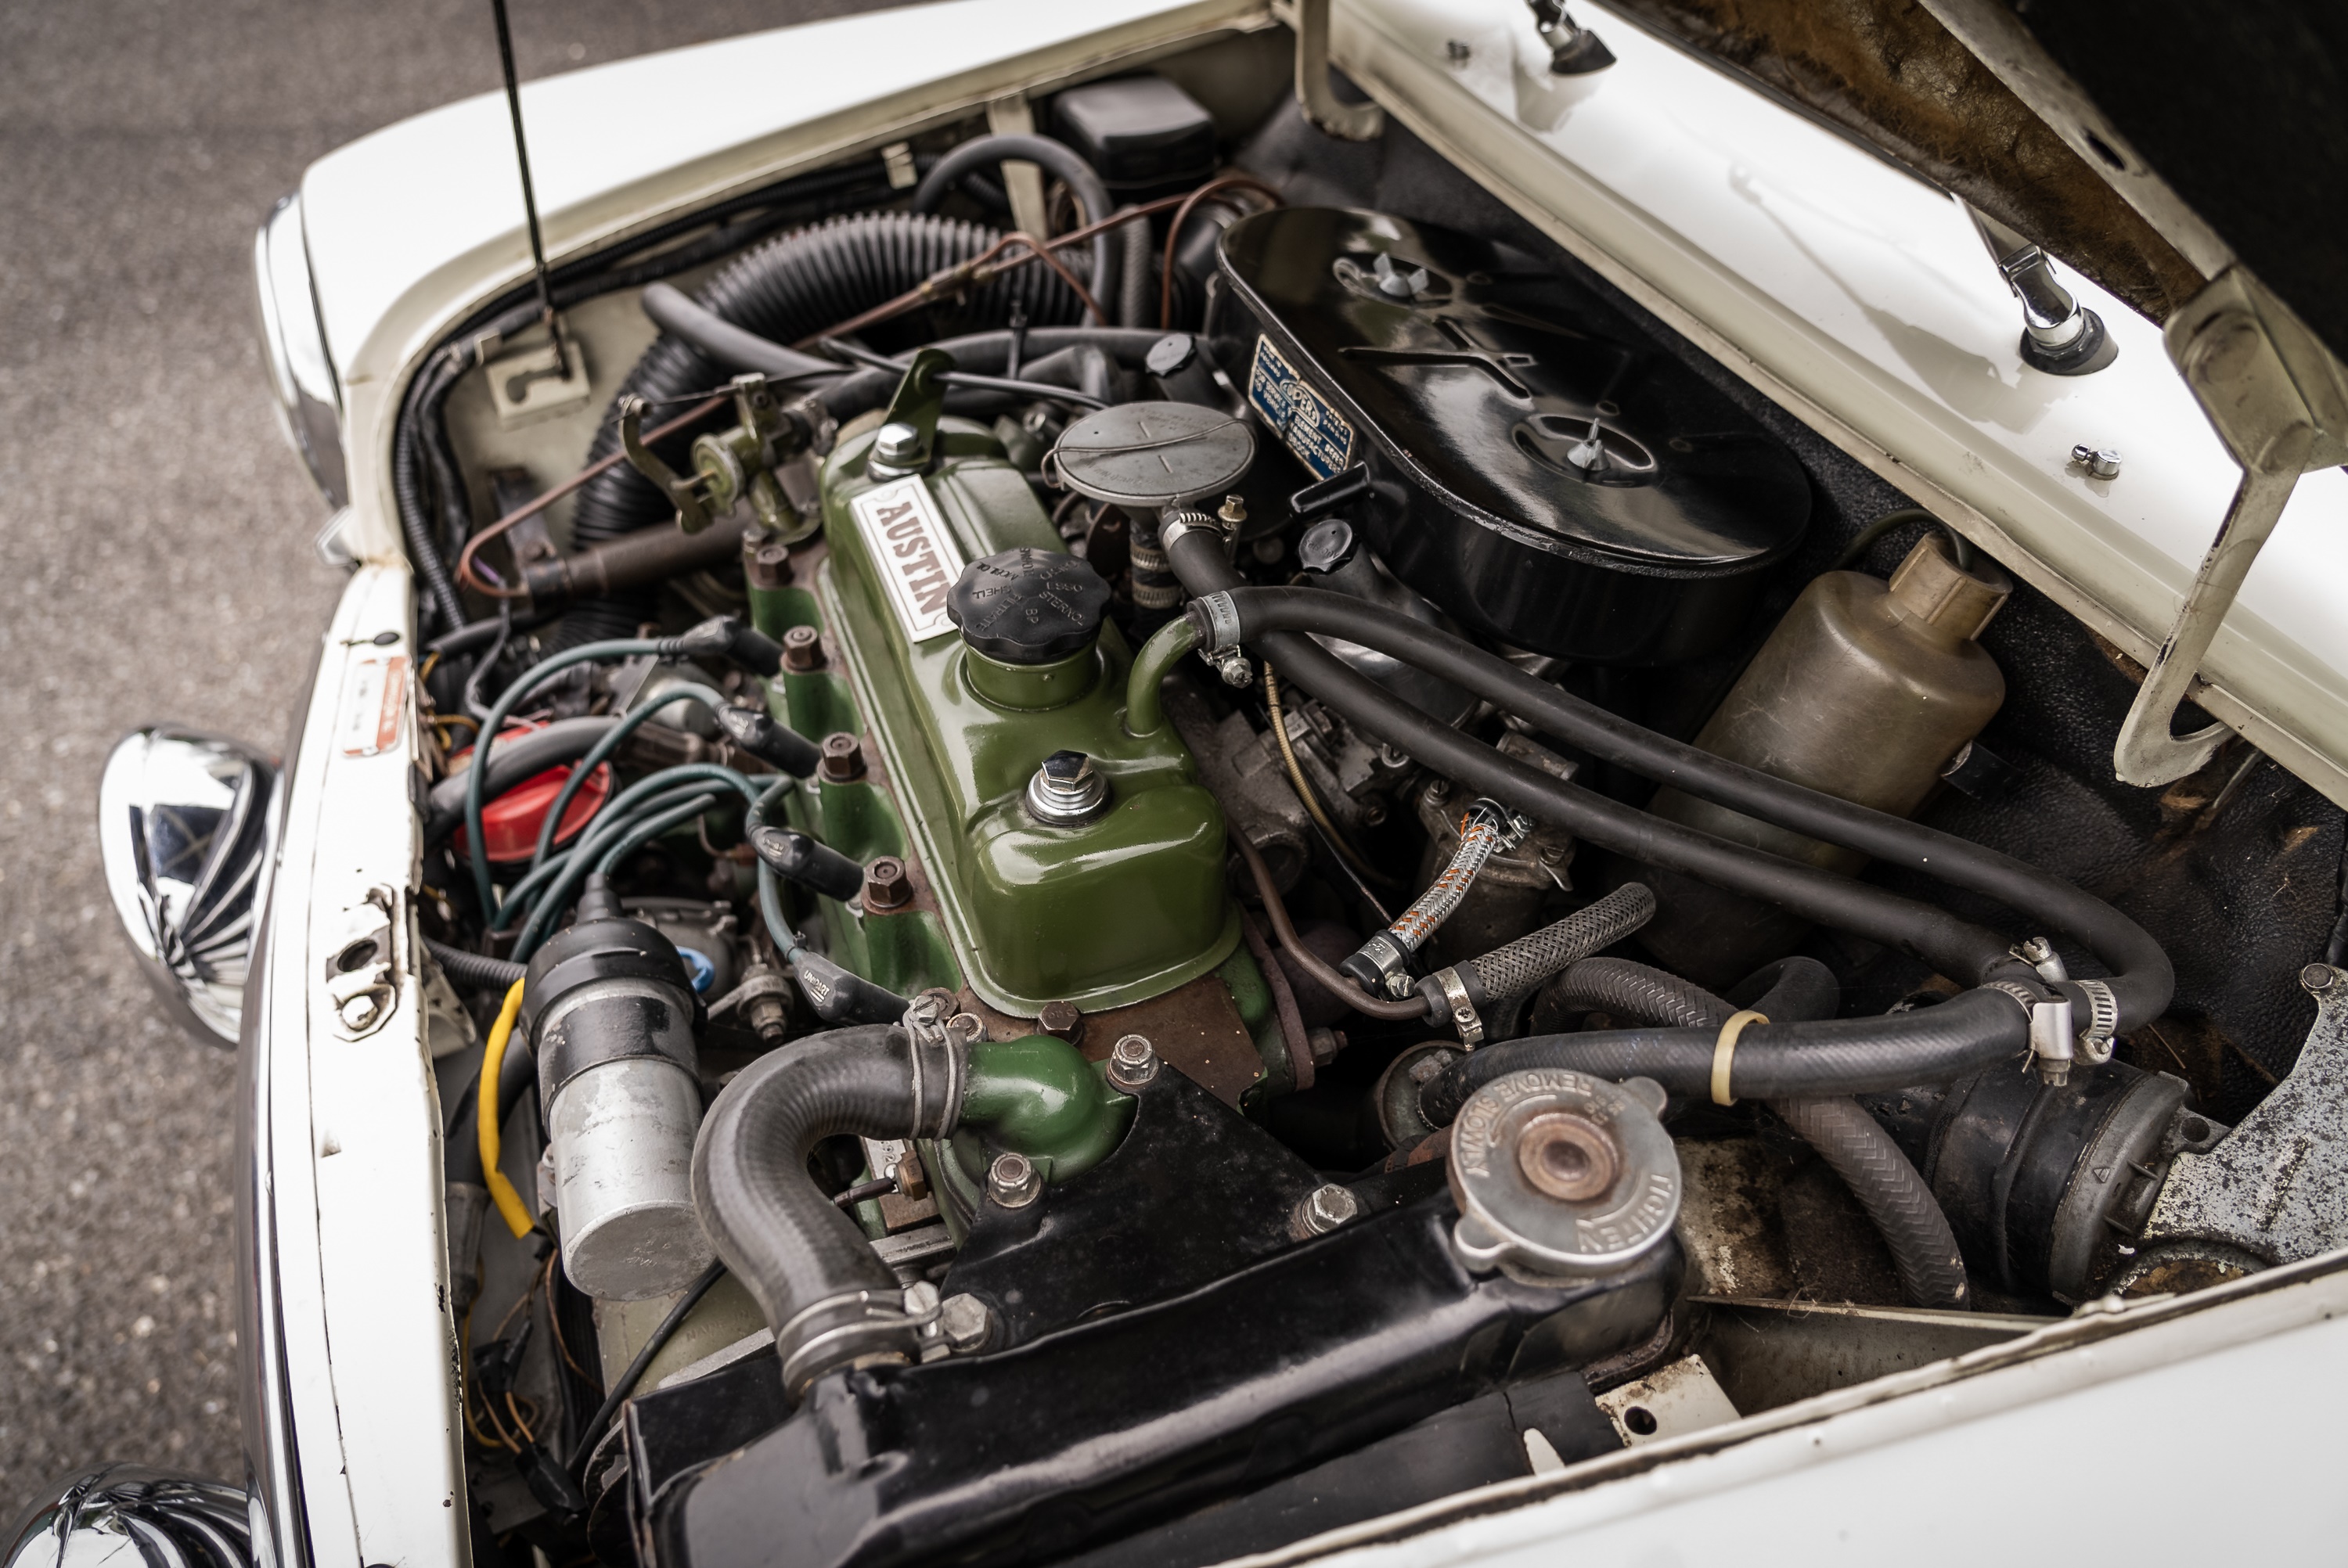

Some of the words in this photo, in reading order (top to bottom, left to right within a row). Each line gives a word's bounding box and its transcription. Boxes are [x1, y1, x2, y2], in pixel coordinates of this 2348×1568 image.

[1295, 415, 1322, 444] ELEMENT
[1325, 444, 1344, 467] REFER
[876, 502, 953, 616] AUSTIN
[972, 585, 1011, 599] SHELL
[1046, 581, 1083, 592] ESSO
[976, 595, 1023, 631] FILTRATE
[1026, 608, 1039, 624] BP
[1039, 592, 1085, 627] STERNOL
[803, 969, 830, 996] UNIPART
[1493, 1074, 1592, 1102] REMOVE
[1460, 1097, 1499, 1178] SLOWLY
[1576, 1174, 1673, 1252] TIGHTEN
